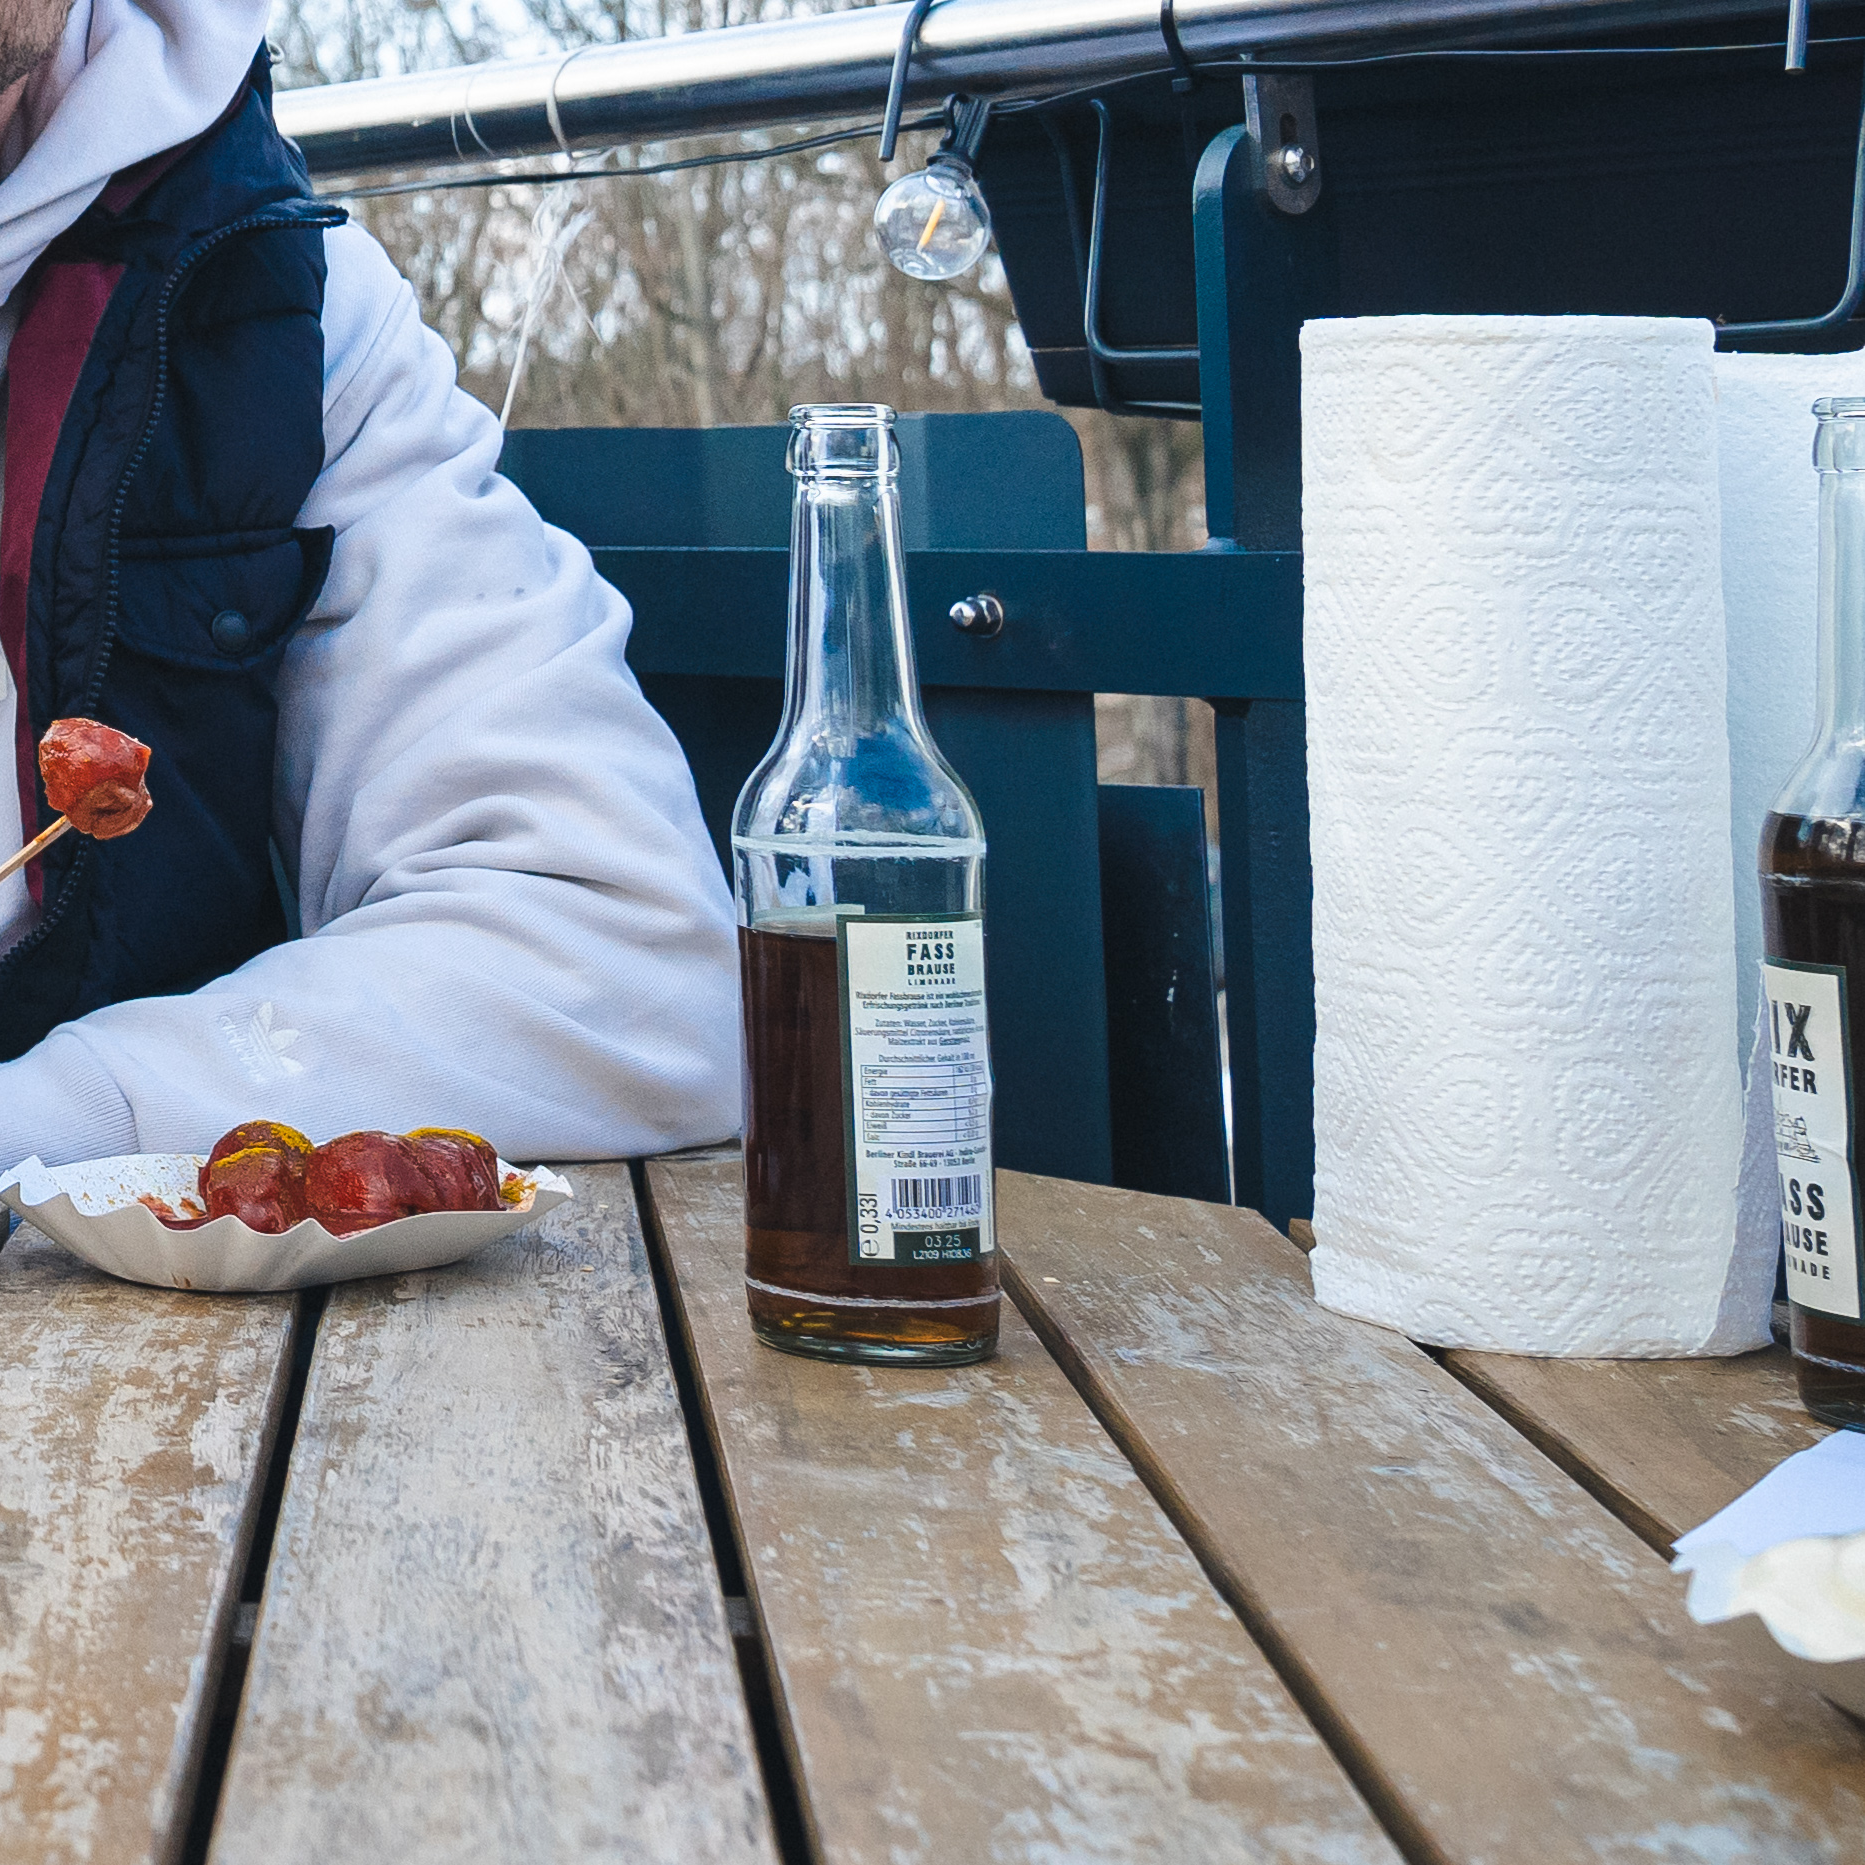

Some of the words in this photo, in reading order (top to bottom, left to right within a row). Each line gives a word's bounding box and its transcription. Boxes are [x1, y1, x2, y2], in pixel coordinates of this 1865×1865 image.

[906, 942, 954, 960] FASS
[907, 963, 955, 976] BRAUSE
[924, 1234, 961, 1248] 03.25
